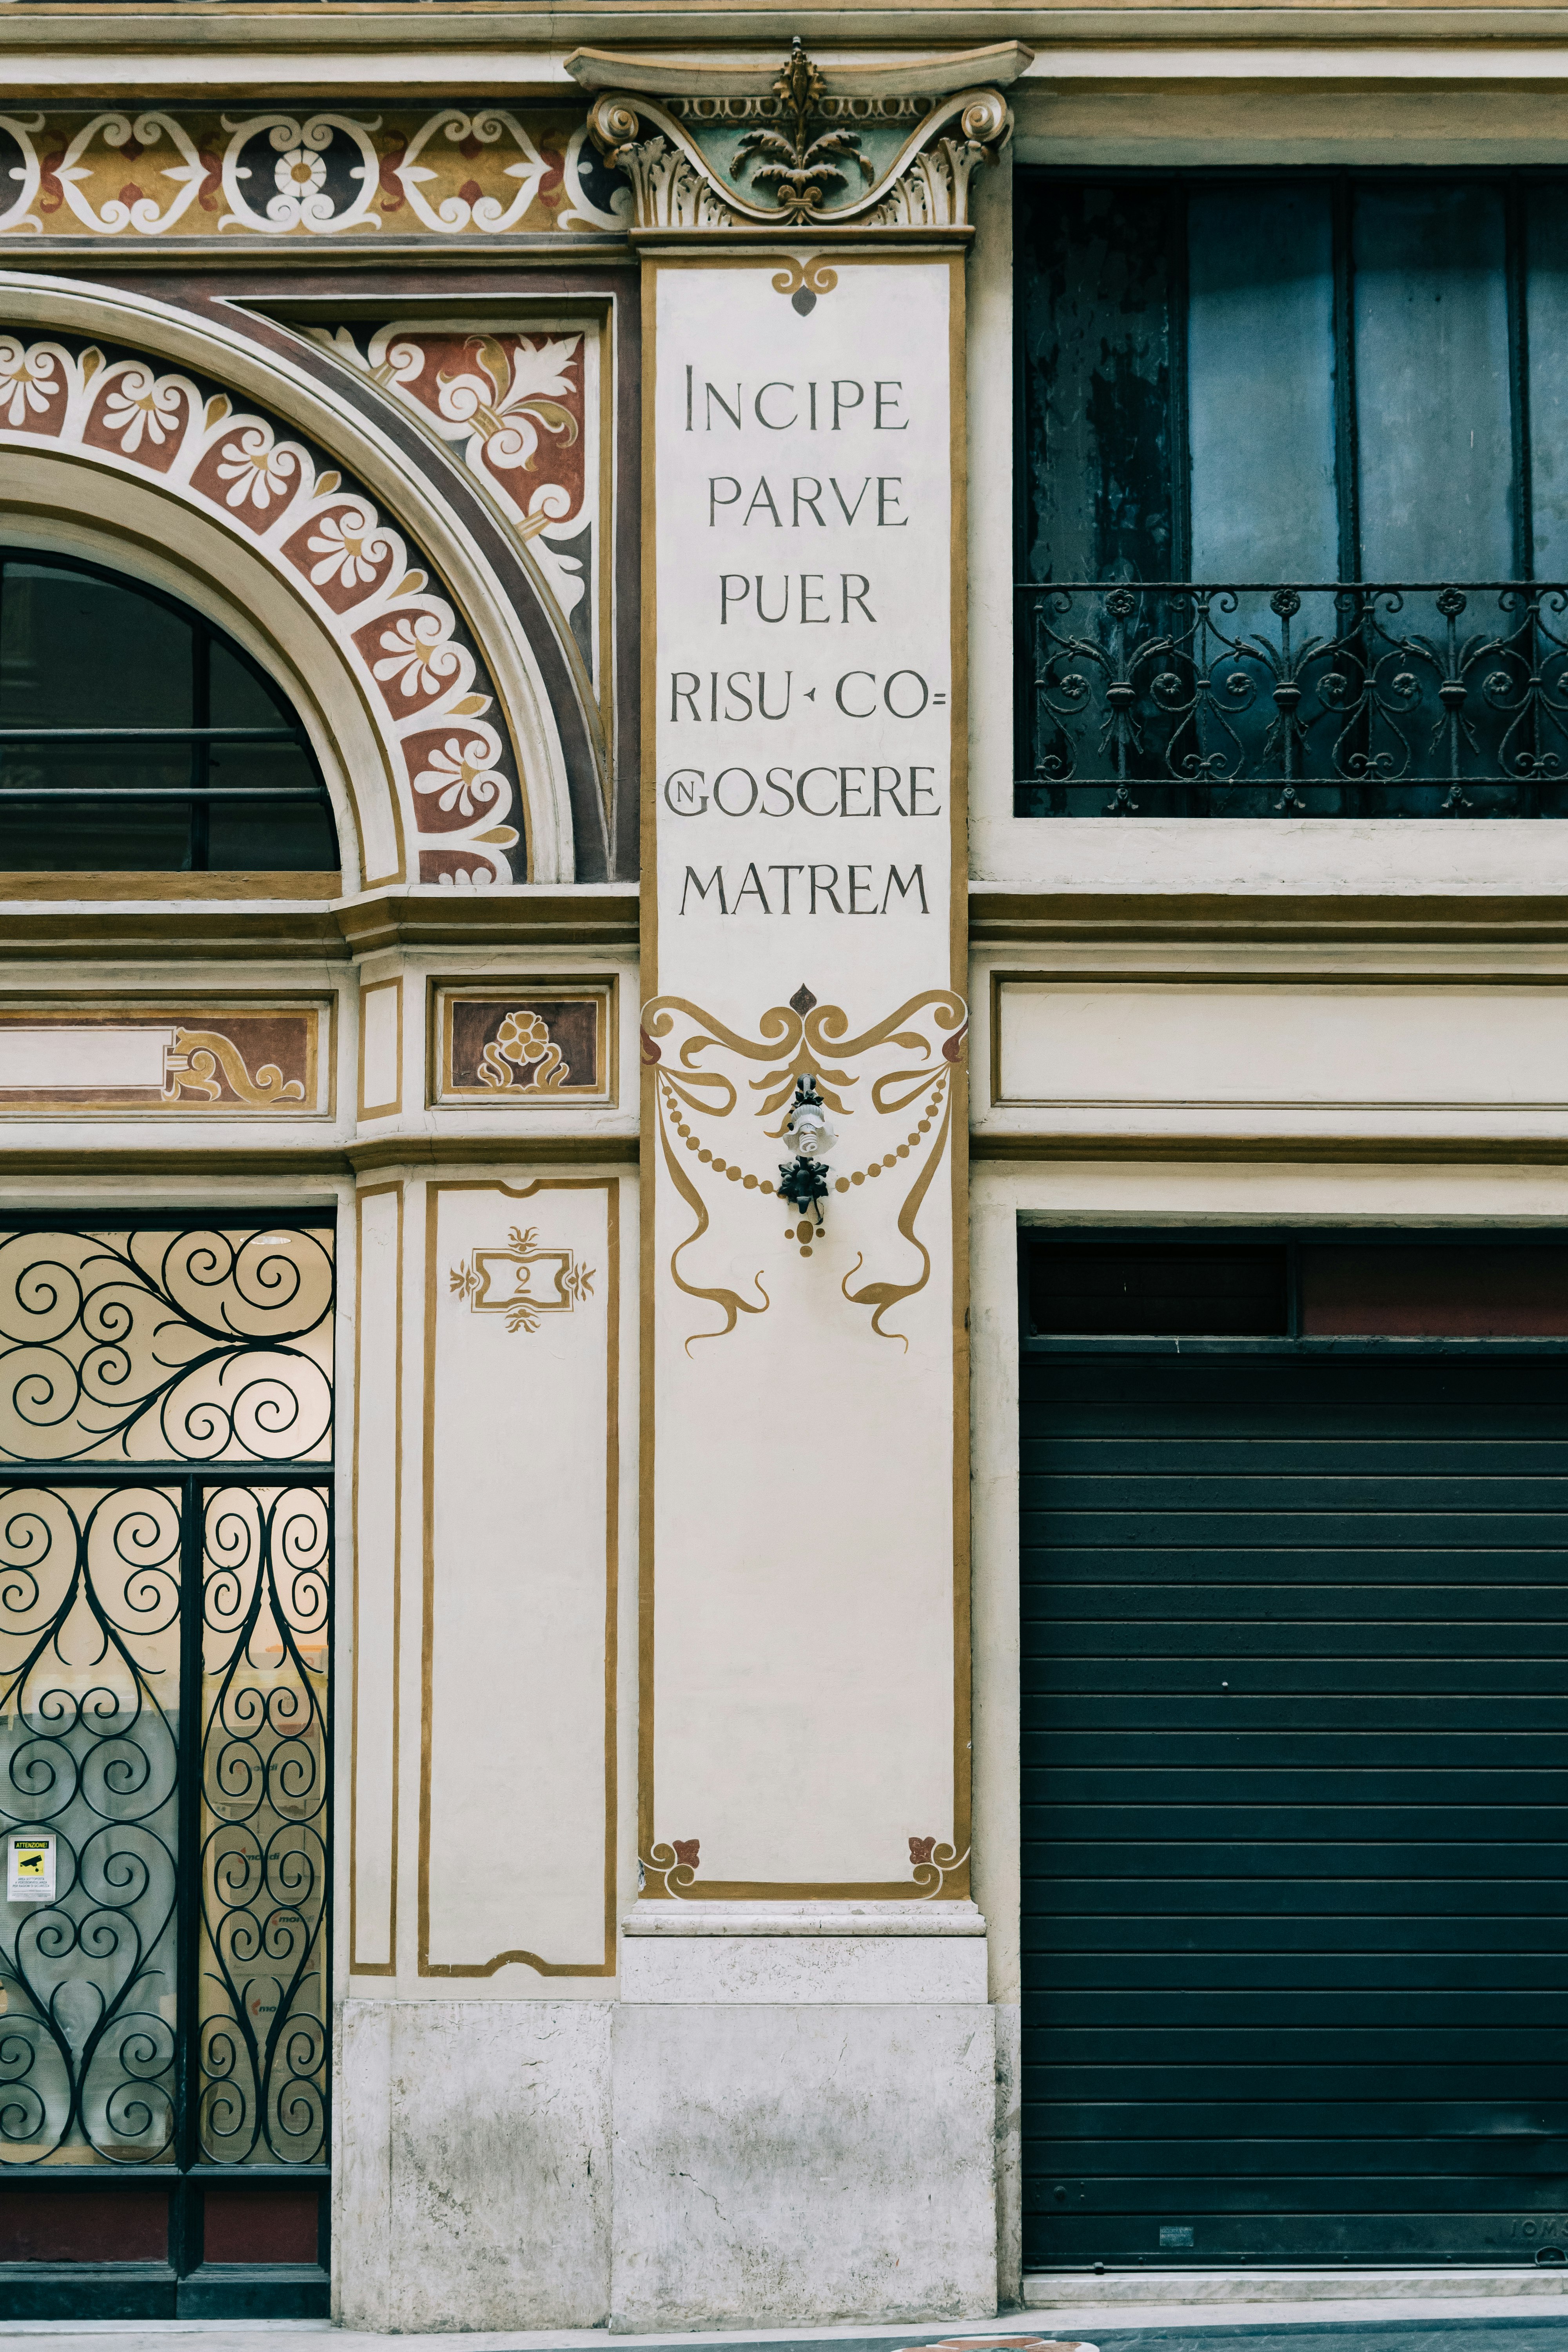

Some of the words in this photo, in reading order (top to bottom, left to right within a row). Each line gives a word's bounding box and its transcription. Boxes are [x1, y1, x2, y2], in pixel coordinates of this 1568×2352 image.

[686, 365, 908, 430] INCIPE
[709, 476, 908, 526] PARVE
[720, 574, 876, 624] PUER
[671, 671, 791, 721] RISU
[679, 863, 929, 915] MATREM
[515, 1267, 531, 1294] 2
